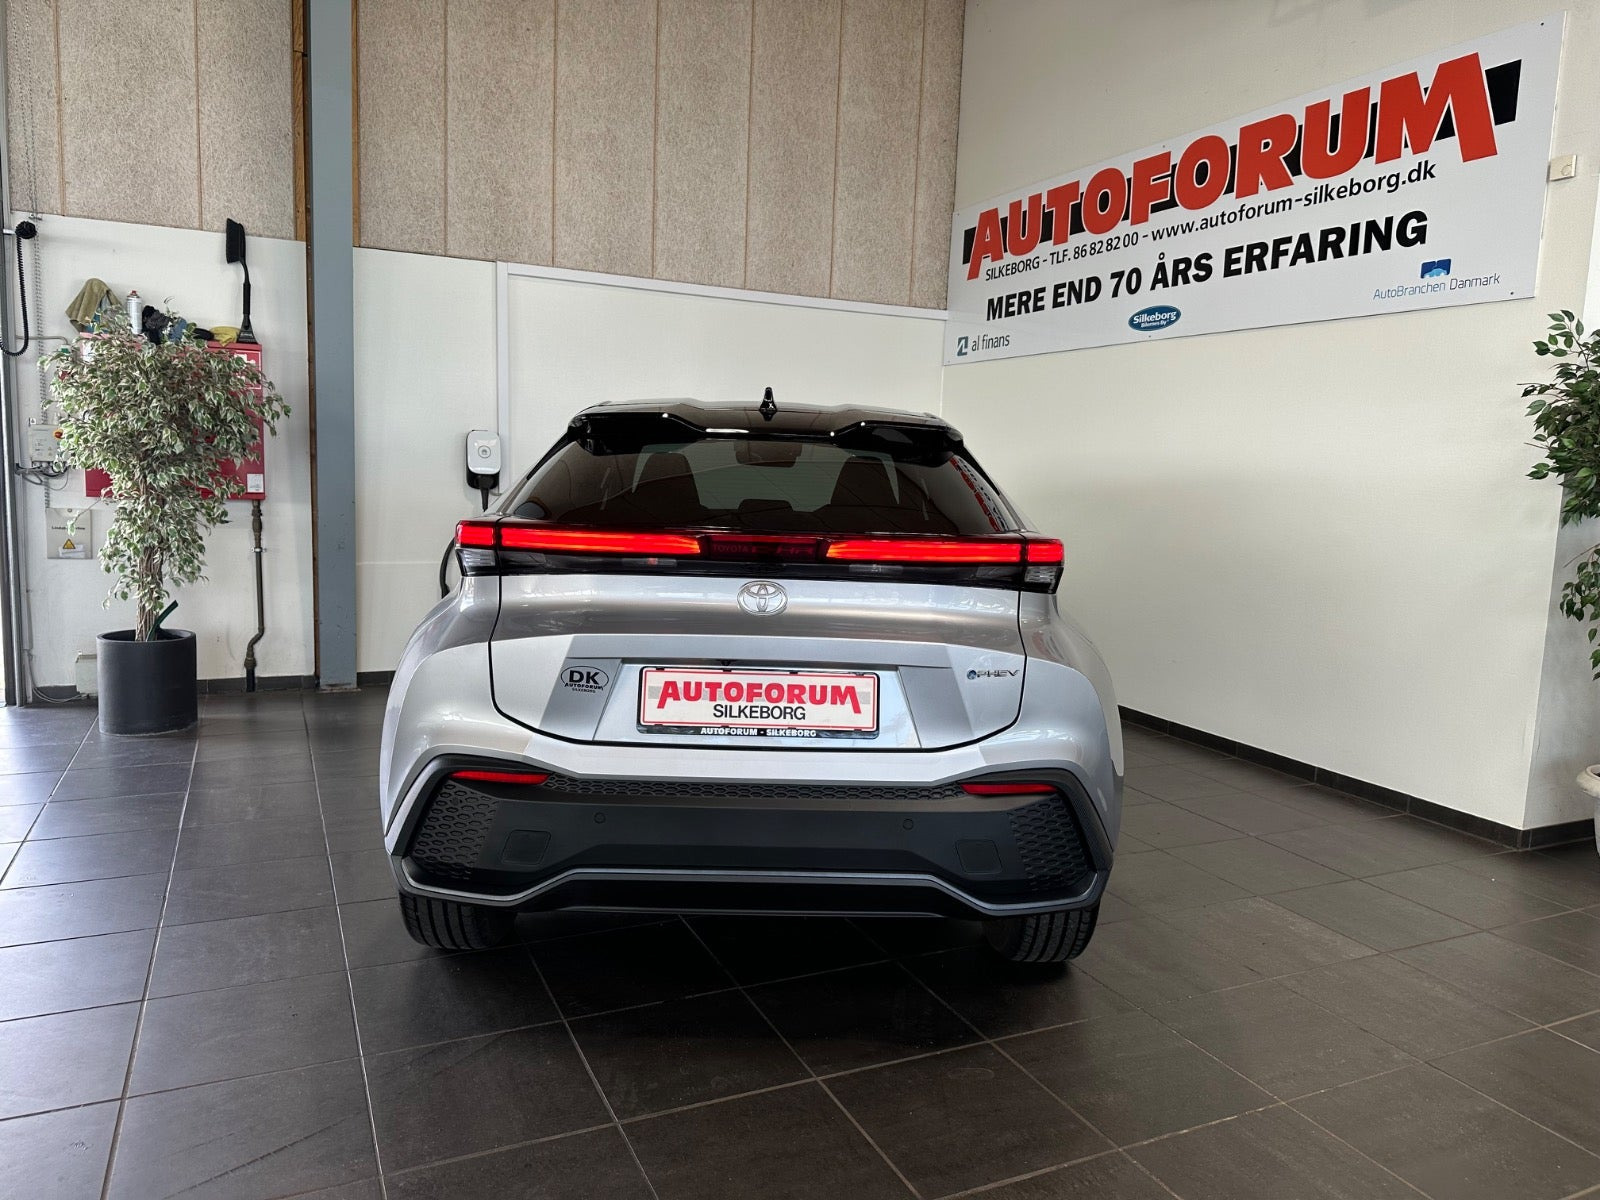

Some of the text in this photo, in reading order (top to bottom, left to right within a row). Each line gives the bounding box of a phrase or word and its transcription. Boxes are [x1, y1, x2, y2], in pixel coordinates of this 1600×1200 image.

[967, 52, 1497, 281] AUTOFORUM
[985, 256, 1040, 281] SILKEBORG
[1049, 249, 1071, 265] TLF.
[1151, 160, 1436, 241] www.autoforum-silkeborg.dk
[986, 210, 1428, 321] MERE END 70 ÅRS ERFARING
[1373, 273, 1500, 300] AutoBranchen Danmark
[1133, 311, 1177, 324] Silkeborg
[971, 334, 1010, 352] al finans
[713, 544, 749, 553] TOYOTA
[569, 669, 600, 685] DK
[976, 669, 1020, 678] PHEV
[564, 682, 604, 691] AUTOFORUM
[656, 680, 862, 715] AUTOFORUM
[712, 704, 806, 720] SILKEBORG
[700, 727, 758, 736] AUTOFORUM
[766, 729, 816, 738] SILKEBORG
